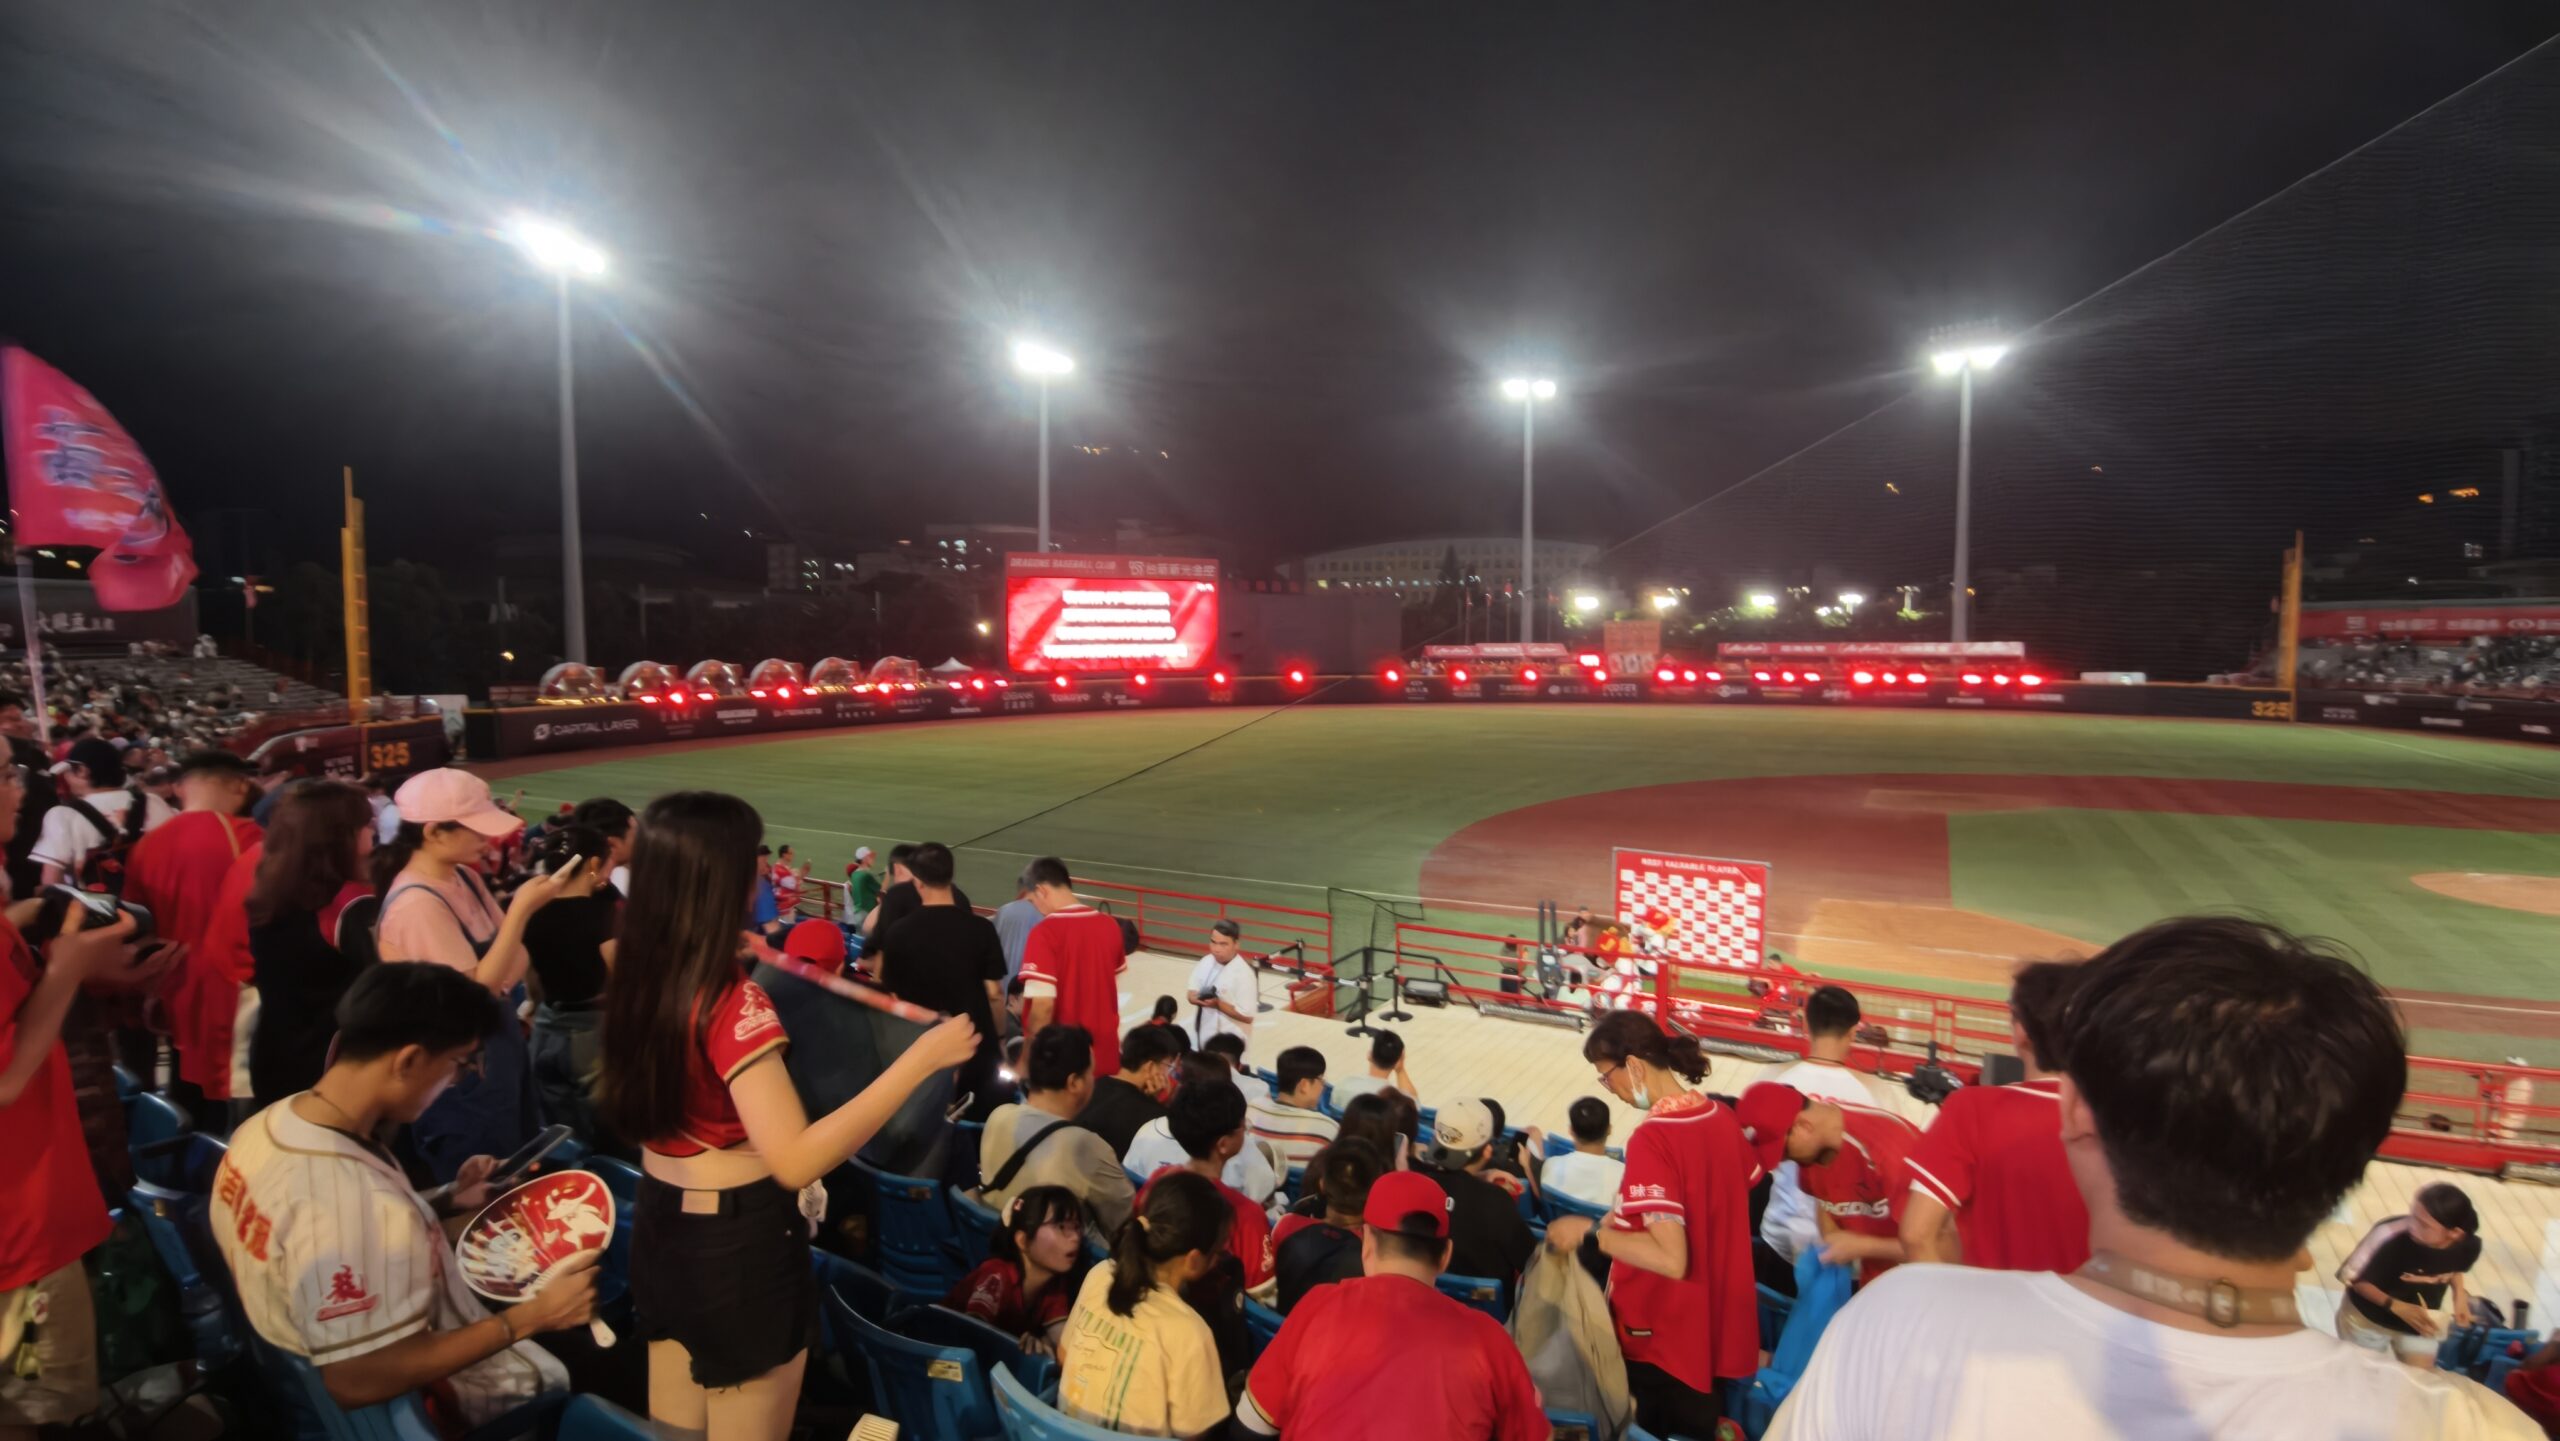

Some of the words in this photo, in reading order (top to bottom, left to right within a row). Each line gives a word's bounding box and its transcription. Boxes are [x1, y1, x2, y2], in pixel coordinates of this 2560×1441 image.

[1051, 558, 1094, 569] BASEBALL
[1095, 560, 1117, 570] CLUB
[2251, 701, 2290, 718] 325
[552, 722, 602, 736] CAPITAL
[603, 718, 639, 731] LAYER
[370, 742, 410, 768] 325
